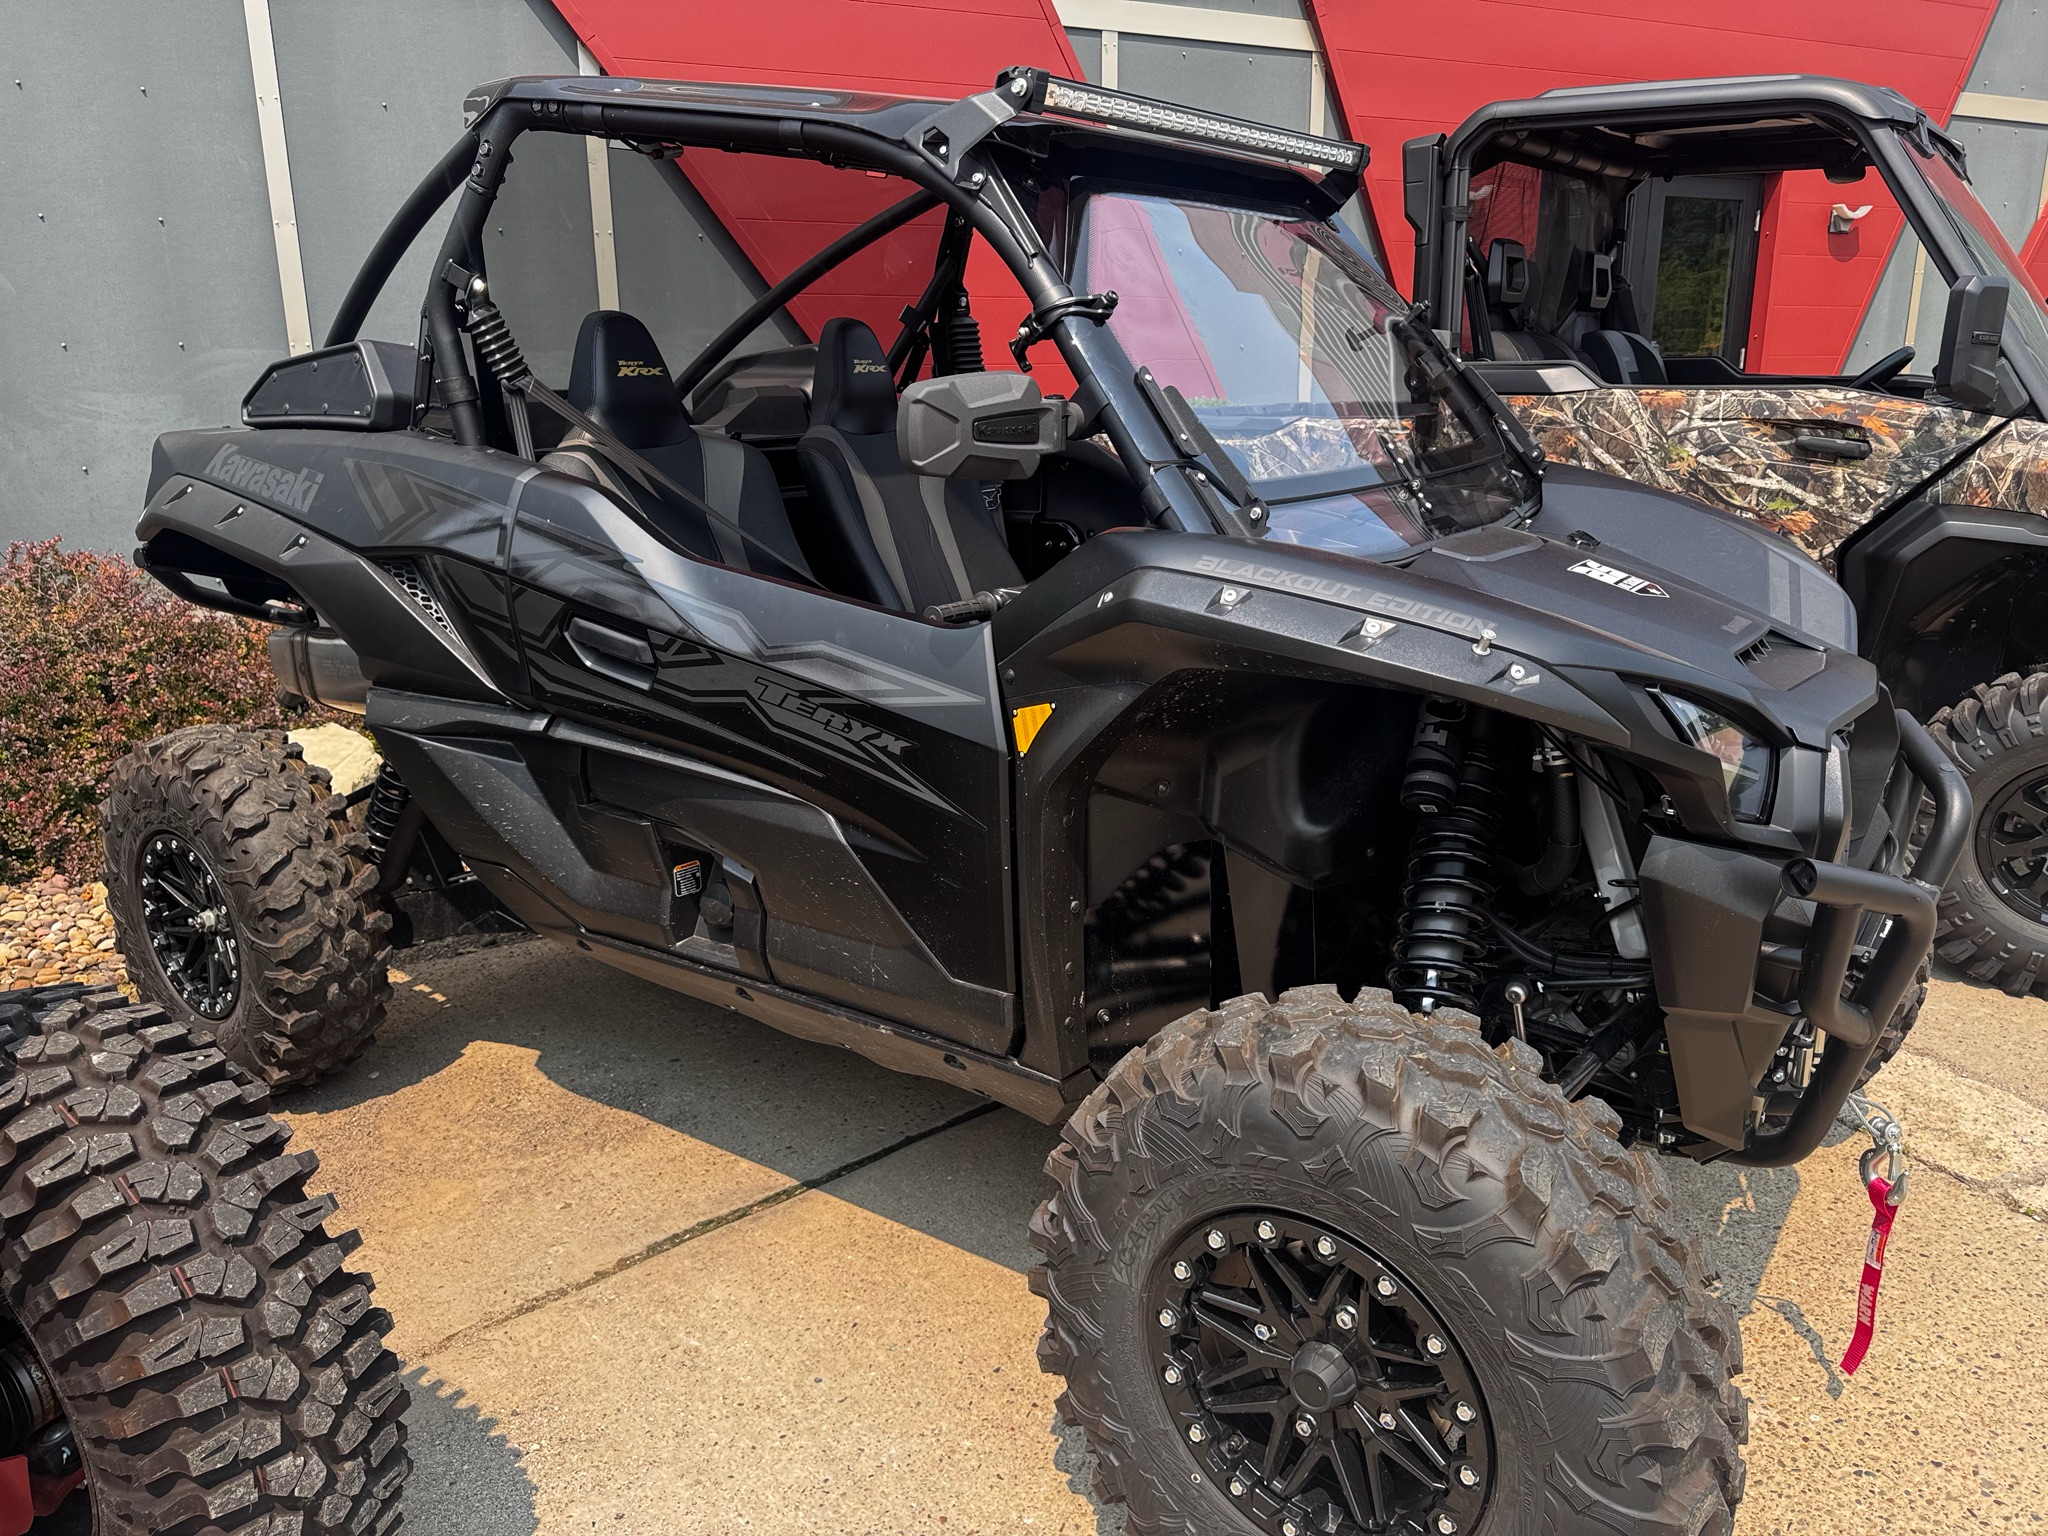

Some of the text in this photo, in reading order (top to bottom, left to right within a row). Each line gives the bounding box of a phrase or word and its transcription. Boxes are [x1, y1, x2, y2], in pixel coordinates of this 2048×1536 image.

[617, 366, 665, 377] KRX
[853, 364, 887, 373] KRX
[203, 442, 326, 513] Kawasaki
[1192, 555, 1499, 634] BLACKOUT EDITION
[754, 676, 914, 756] TERYX
[1858, 1282, 1875, 1327] WARN
